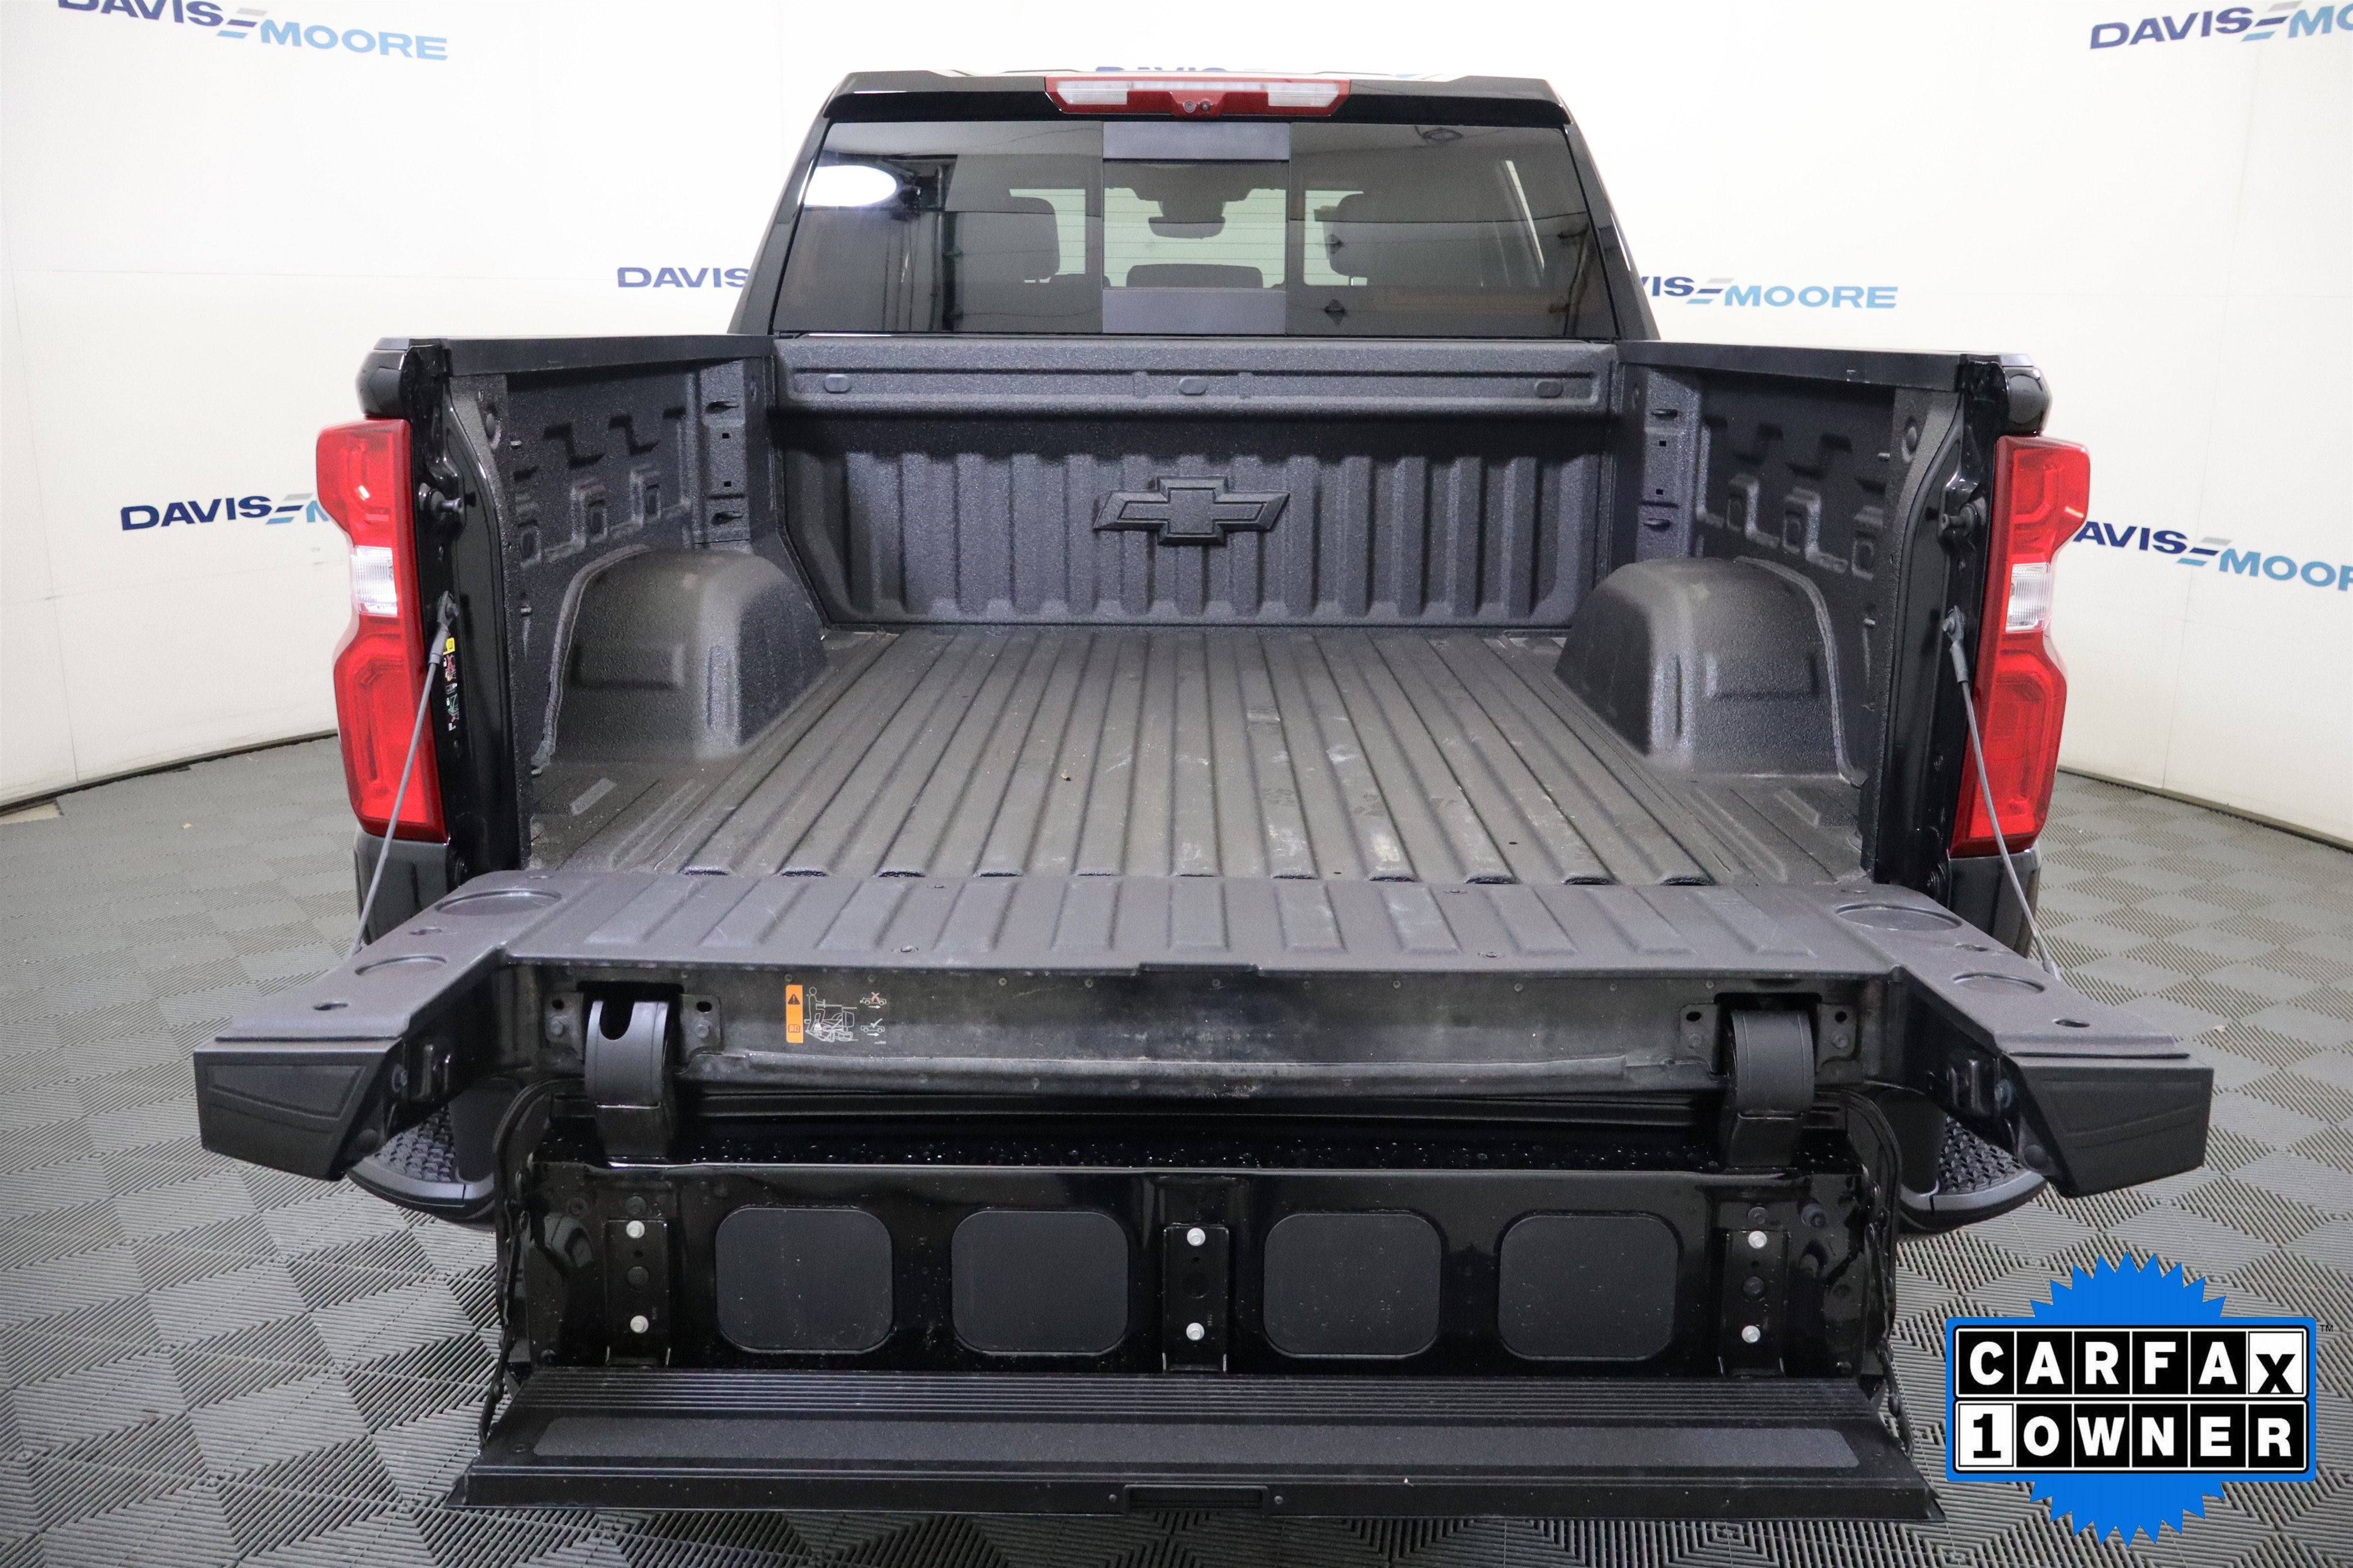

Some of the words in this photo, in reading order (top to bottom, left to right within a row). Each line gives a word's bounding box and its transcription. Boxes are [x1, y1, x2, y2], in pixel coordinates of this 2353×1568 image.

[260, 19, 448, 60] MOORE
[2090, 7, 2254, 49] DAVIS
[617, 267, 750, 288] DAVIS
[1725, 285, 1898, 308] MOORE
[121, 496, 272, 530] DAVIS
